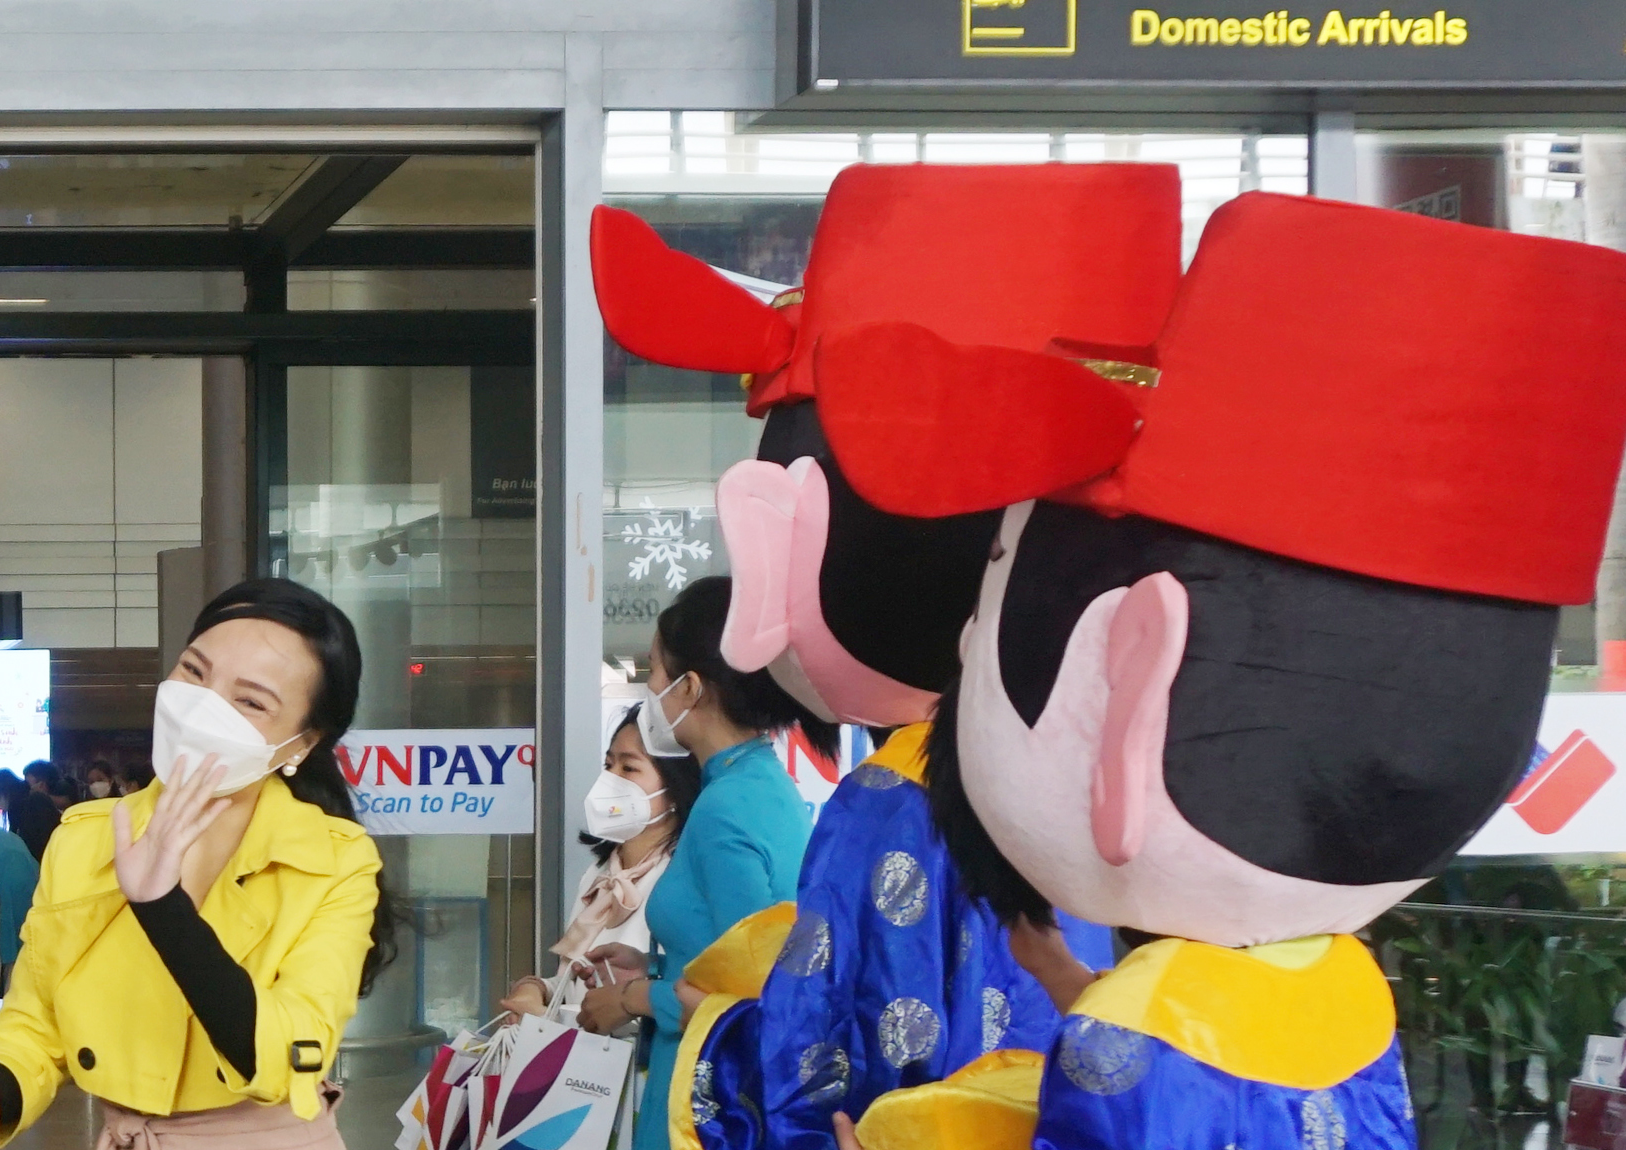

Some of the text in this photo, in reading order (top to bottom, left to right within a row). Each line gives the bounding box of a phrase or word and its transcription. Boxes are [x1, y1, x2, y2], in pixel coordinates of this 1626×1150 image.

[1131, 9, 1468, 46] Domestic Arrivals
[357, 792, 495, 817] Scan to Pay
[565, 1078, 611, 1096] DANANG
